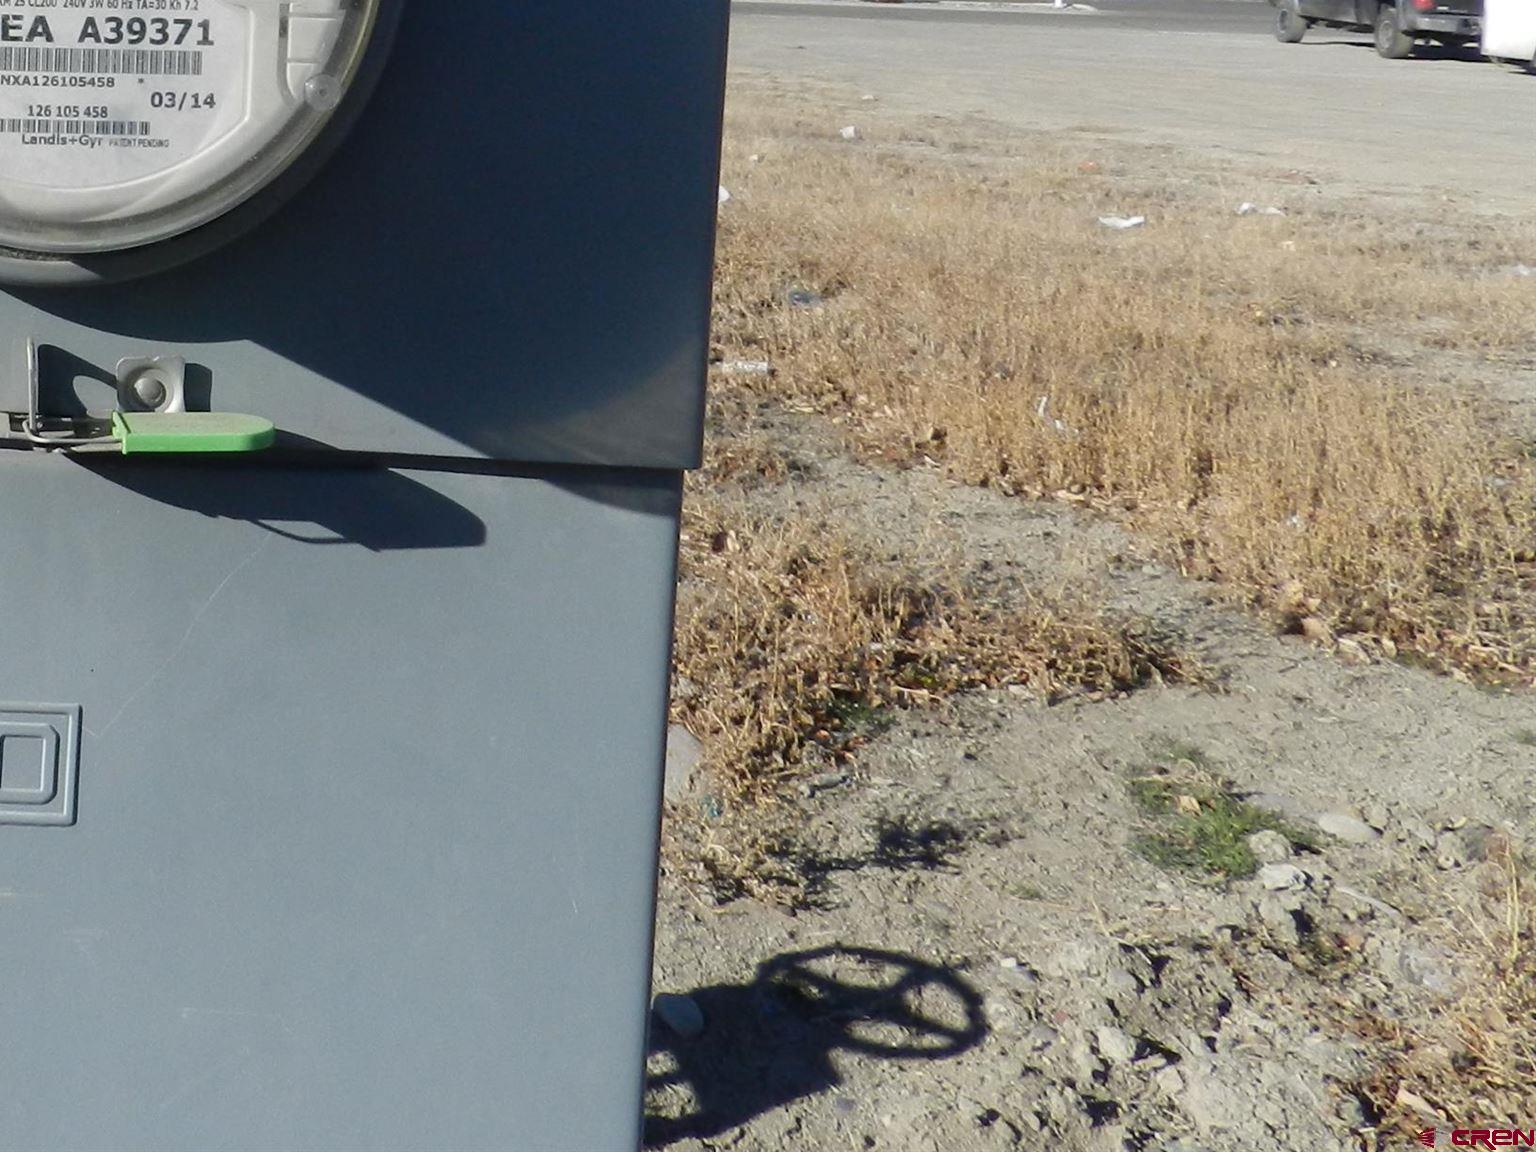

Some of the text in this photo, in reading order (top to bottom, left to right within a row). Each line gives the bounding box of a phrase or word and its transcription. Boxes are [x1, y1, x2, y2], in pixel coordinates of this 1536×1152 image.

[136, 0, 167, 10] TA=30
[169, 0, 182, 11] Kh
[184, 0, 199, 11] 7.2
[77, 16, 215, 46] A39371
[150, 91, 216, 111] 03/14
[27, 105, 108, 119] 126 105 458
[21, 133, 104, 148] Landis+Gyr
